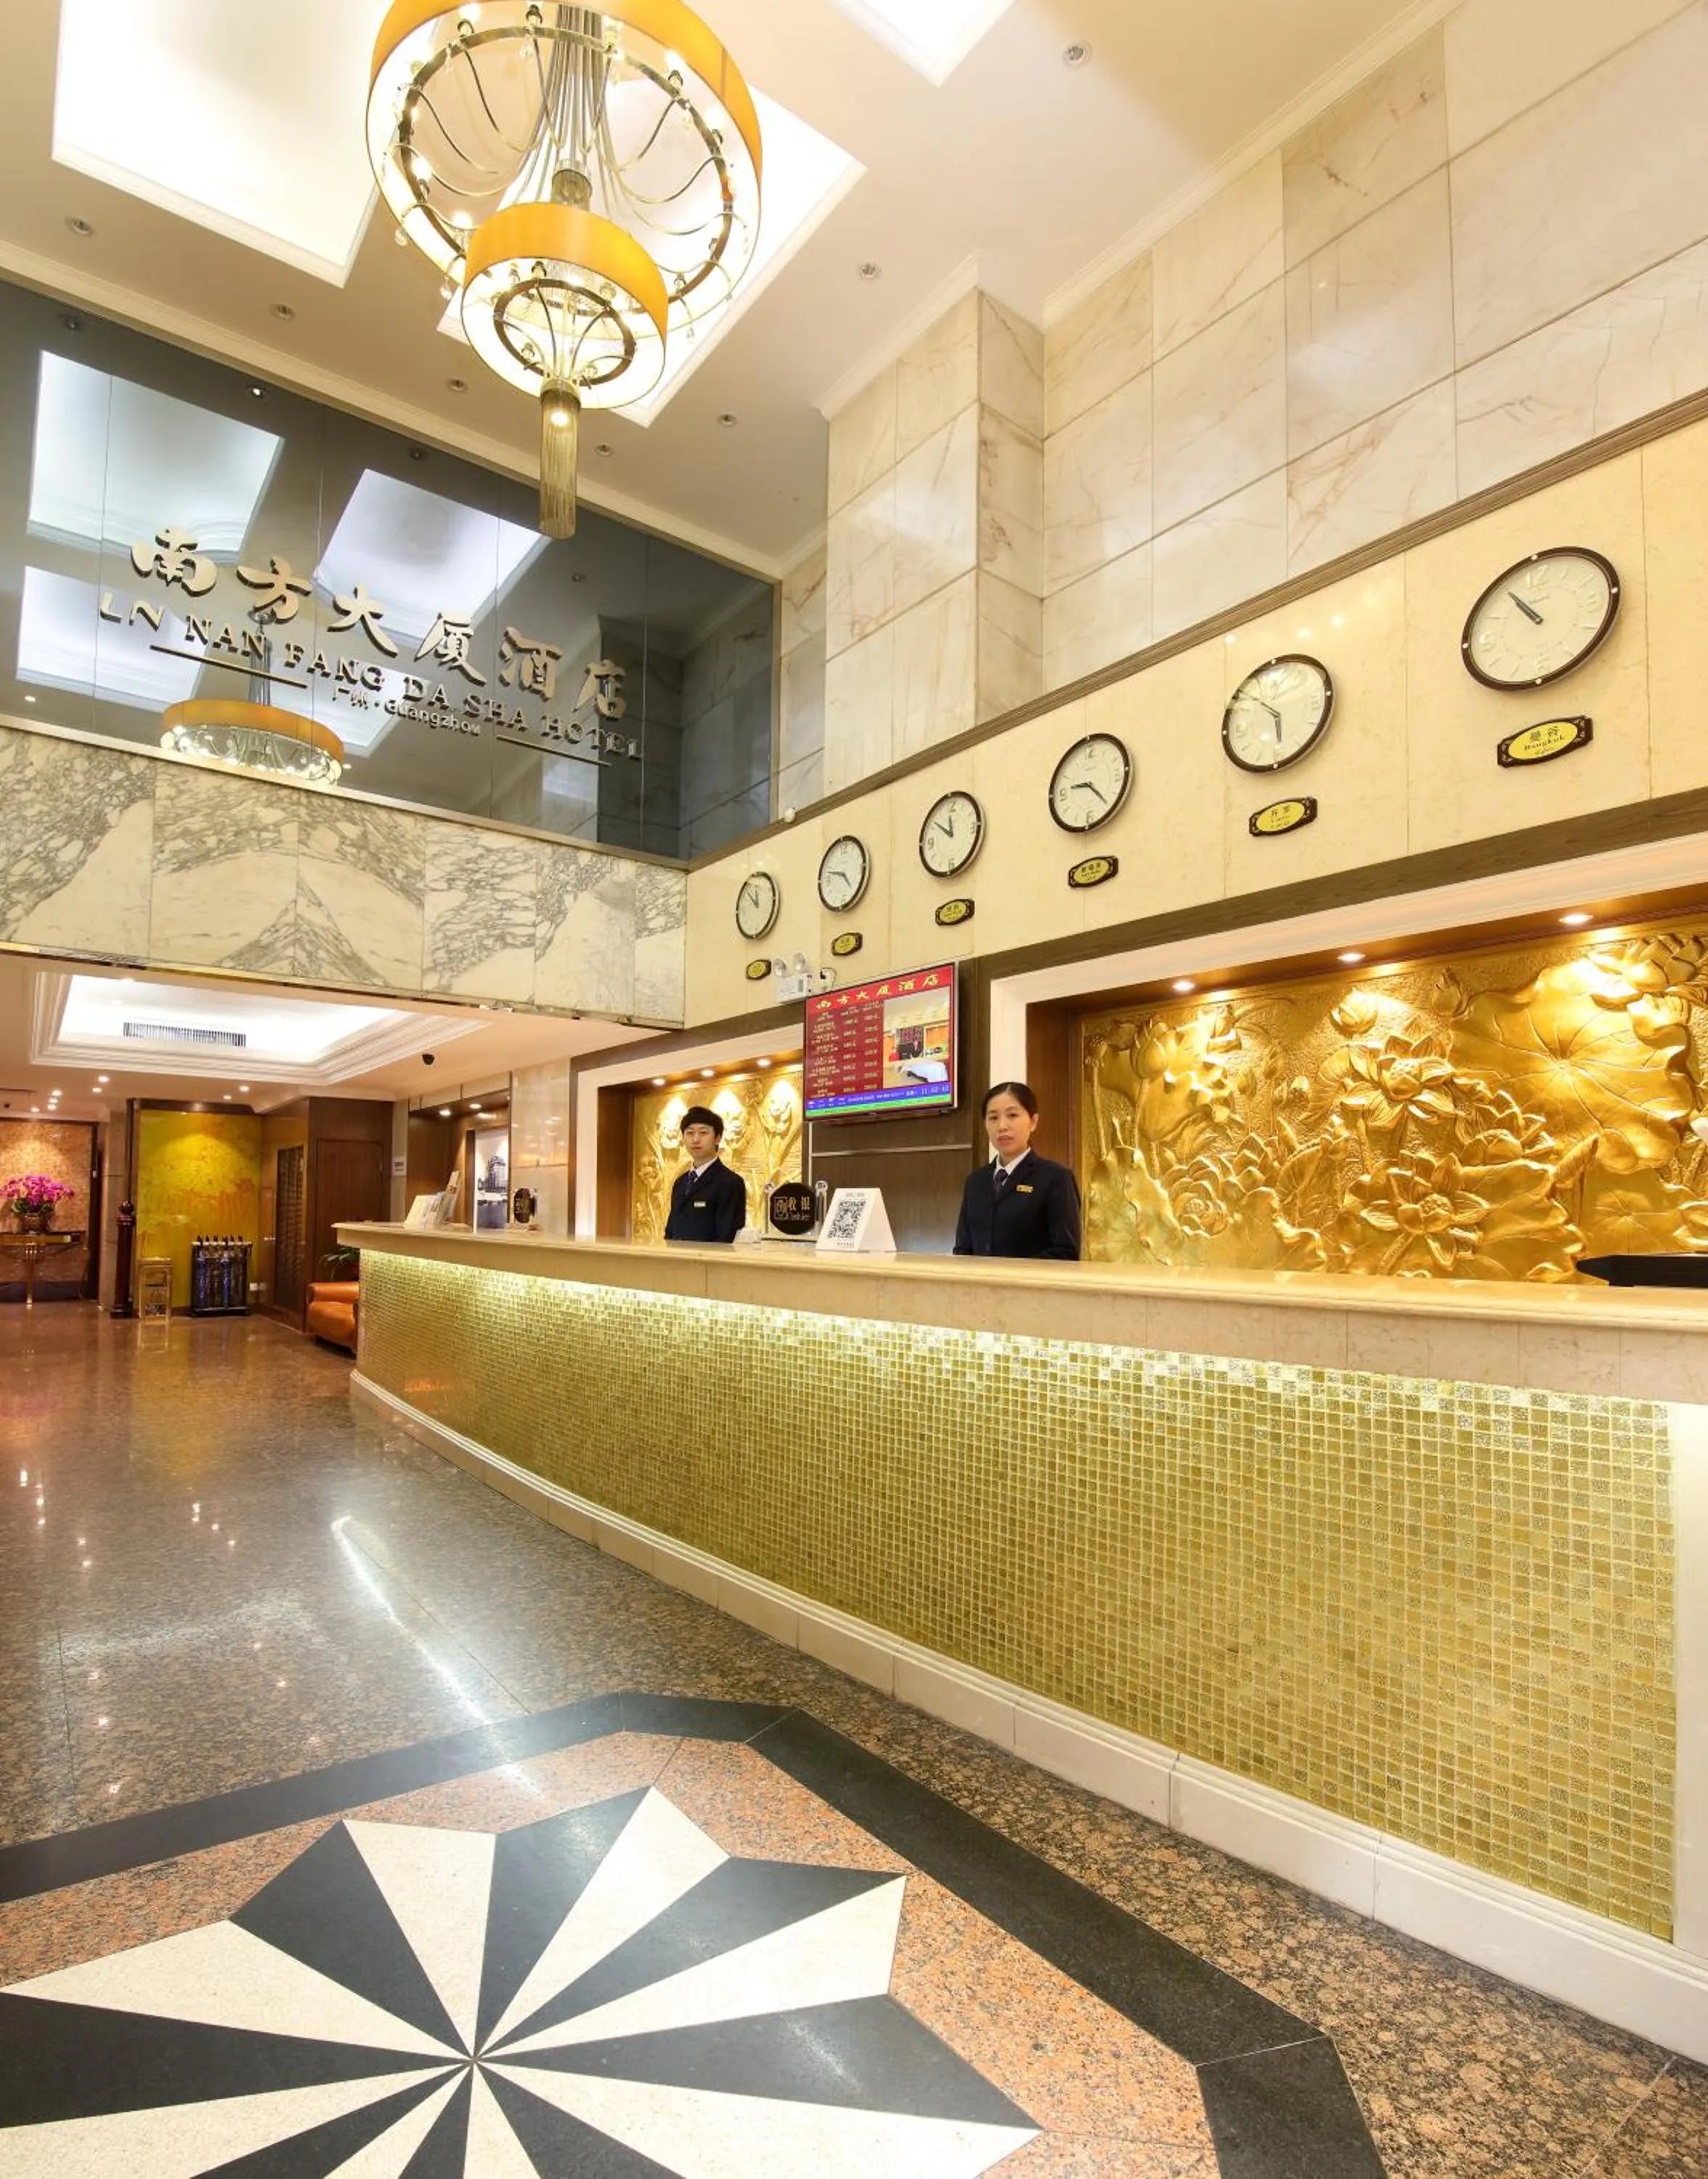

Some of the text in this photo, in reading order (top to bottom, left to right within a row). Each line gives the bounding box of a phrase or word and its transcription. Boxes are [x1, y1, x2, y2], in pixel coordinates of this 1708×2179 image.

[99, 591, 643, 760] LN NAN FANG DA SHA HOTEL
[131, 527, 627, 721] 南方大厦酒店
[384, 697, 481, 737] Guangzhou
